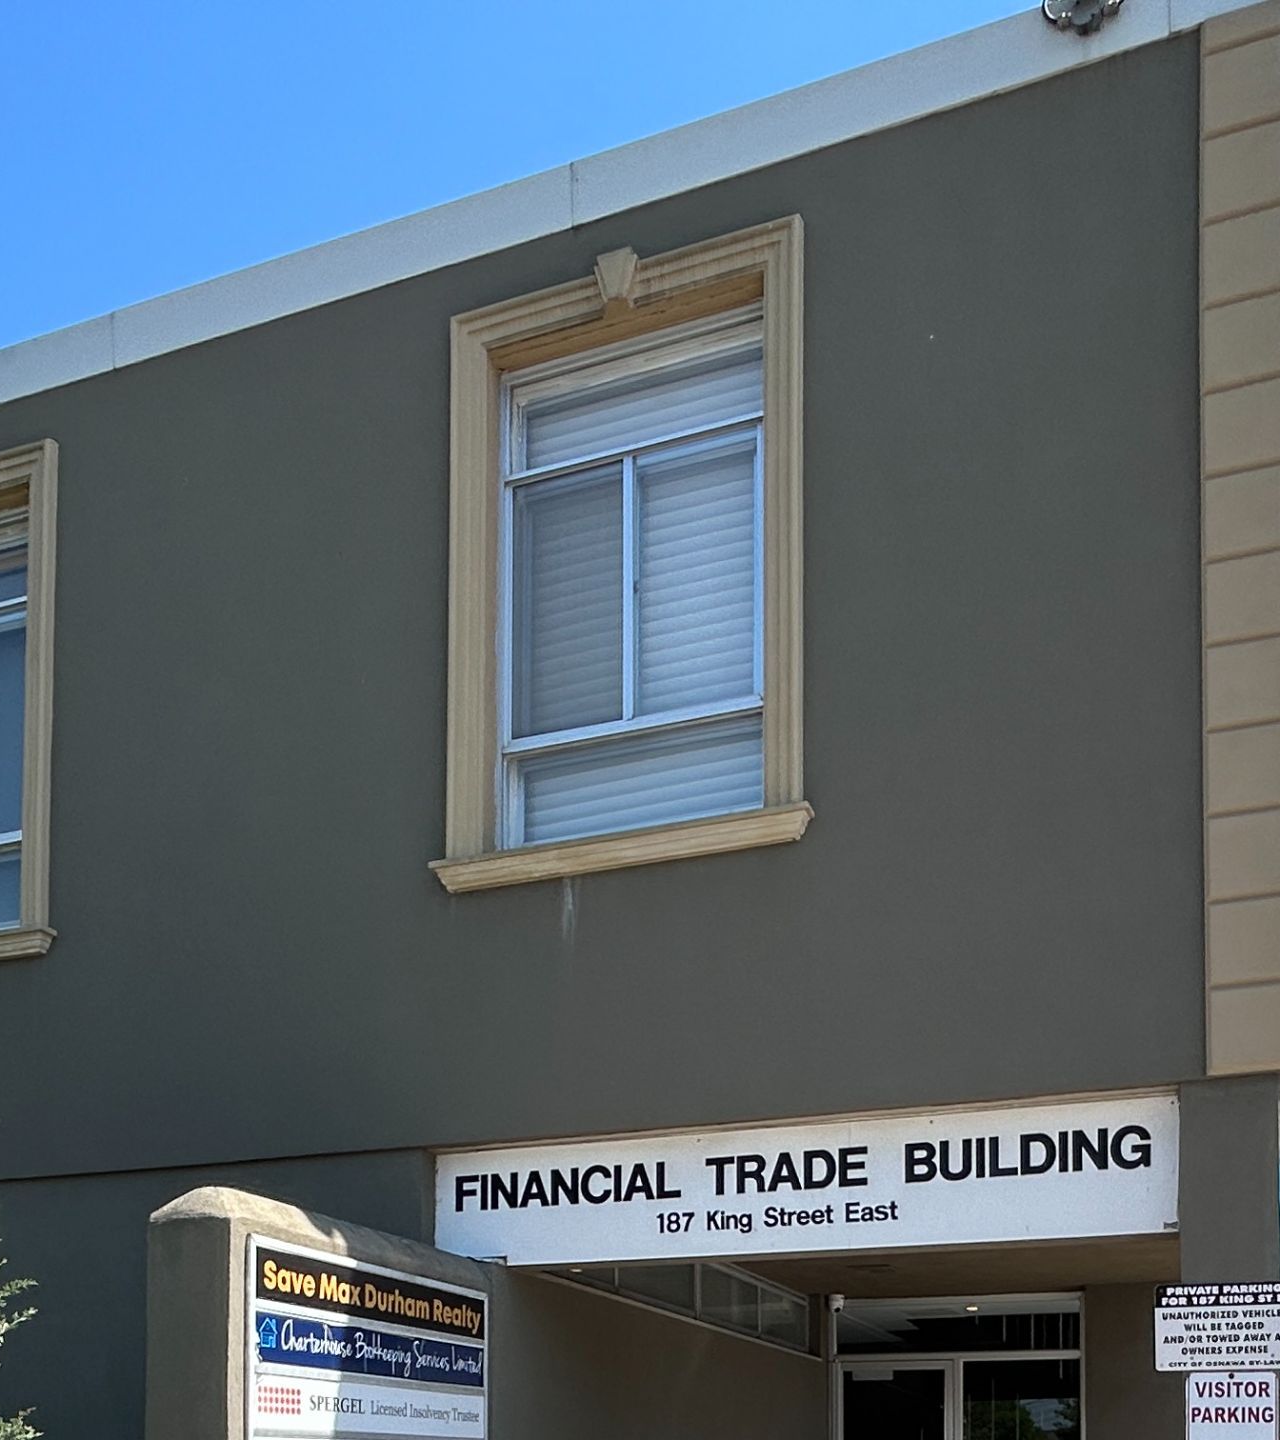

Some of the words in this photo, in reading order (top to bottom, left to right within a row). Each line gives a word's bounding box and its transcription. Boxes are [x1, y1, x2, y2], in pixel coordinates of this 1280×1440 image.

[454, 1162, 681, 1212] FINANCIAL
[705, 1146, 868, 1196] TRADE
[904, 1124, 1151, 1183] BUILDING
[657, 1211, 695, 1233] 187
[706, 1210, 752, 1233] King
[764, 1204, 834, 1227] Street
[845, 1201, 898, 1223] East
[263, 1259, 316, 1297] Save
[320, 1273, 361, 1308] Max
[365, 1283, 430, 1320] Durham
[433, 1298, 481, 1334] Realty
[1166, 1286, 1219, 1296] PRIVATE
[1161, 1297, 1187, 1306] FOR
[1192, 1296, 1216, 1305] 187
[1219, 1295, 1254, 1304] KING
[1257, 1294, 1274, 1303] ST
[1162, 1310, 1238, 1320] UNAUTHORIZED
[1184, 1323, 1207, 1332] WILL
[1210, 1322, 1222, 1331] BE
[1225, 1321, 1264, 1330] TAGGED
[1163, 1335, 1203, 1344] AND/OR
[1206, 1334, 1240, 1343] TOWED
[1243, 1333, 1271, 1342] AWAY
[281, 1319, 353, 1358] Charterhouse
[354, 1331, 411, 1377] Bookkeeping
[413, 1340, 450, 1372] Services
[452, 1345, 482, 1376] Limited
[1181, 1346, 1222, 1355] OWNERS
[1226, 1345, 1268, 1354] EXPENSE
[1194, 1381, 1270, 1398] VISITOR
[309, 1395, 366, 1415] SPERGEL
[371, 1400, 407, 1417] Licensed
[410, 1403, 451, 1424] Insolvency
[452, 1407, 480, 1422] Trustee
[1191, 1406, 1274, 1423] PARKING
